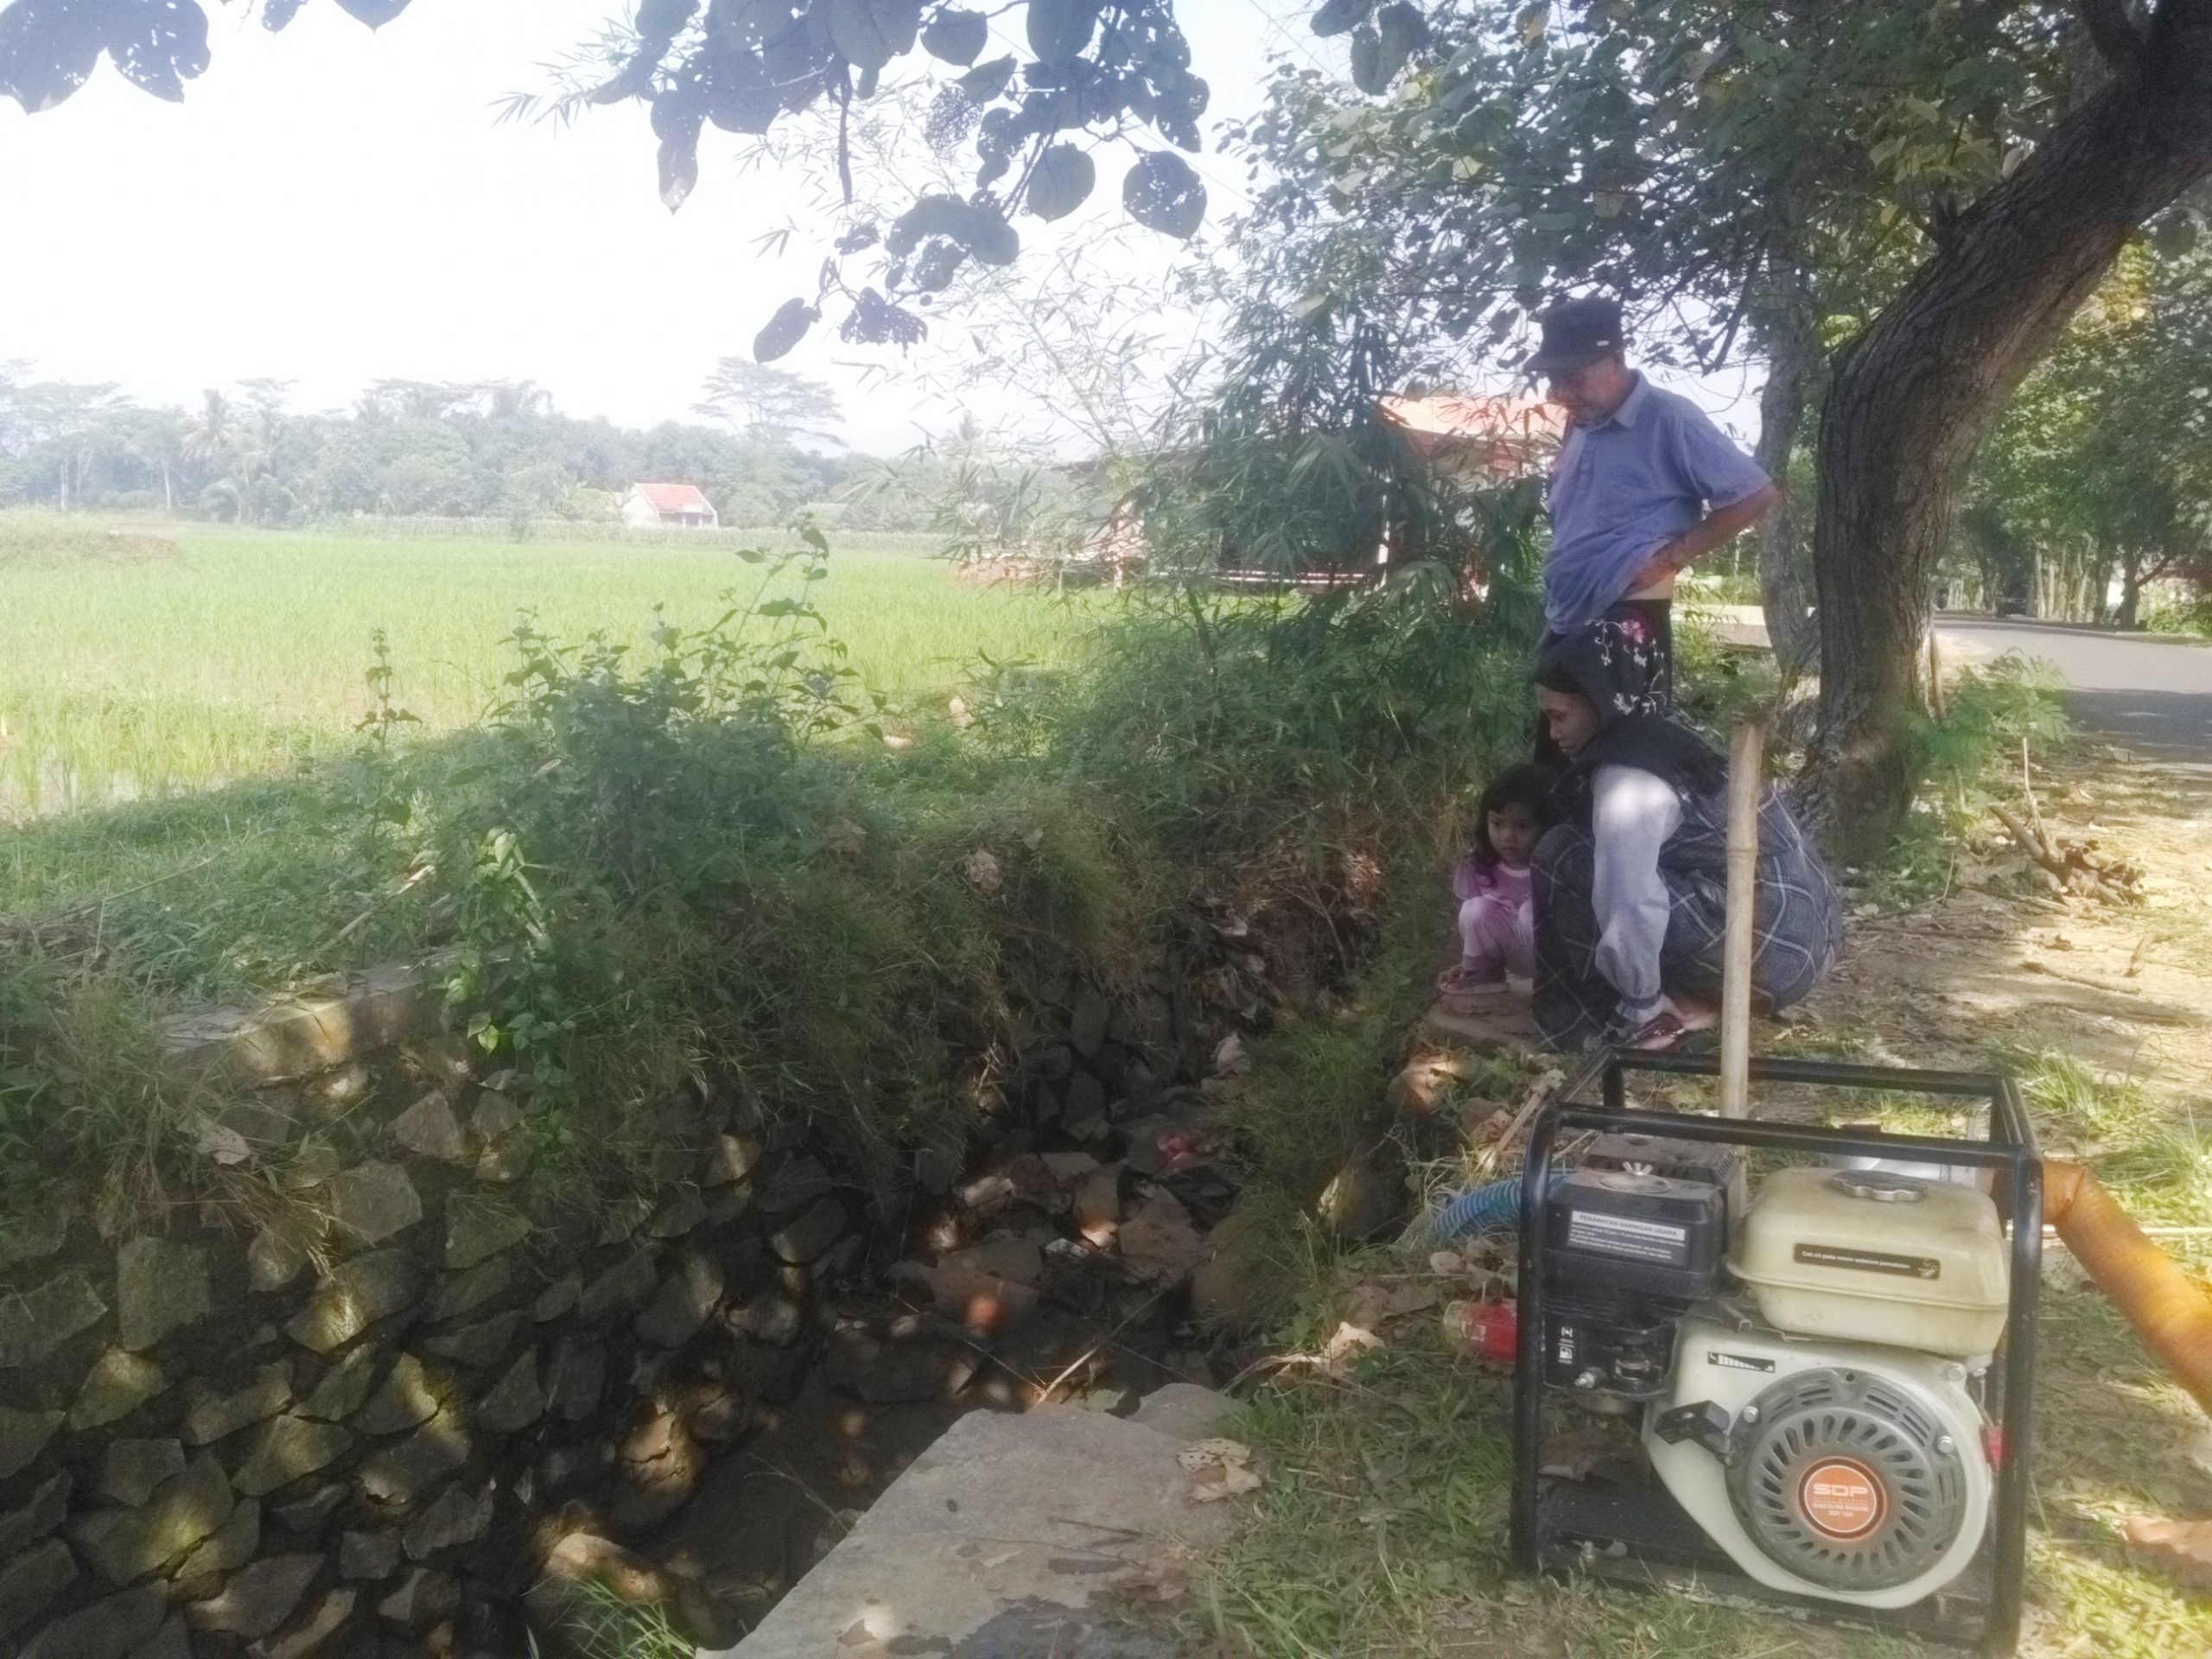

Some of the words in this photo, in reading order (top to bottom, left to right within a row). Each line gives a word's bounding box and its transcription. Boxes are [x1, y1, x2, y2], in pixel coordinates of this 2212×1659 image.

[1580, 1214, 1618, 1226] PERAWATAN
[1619, 1220, 1653, 1232] SARINGAN
[1655, 1225, 1677, 1236] UDARA
[1813, 1483, 1867, 1497] SDP
